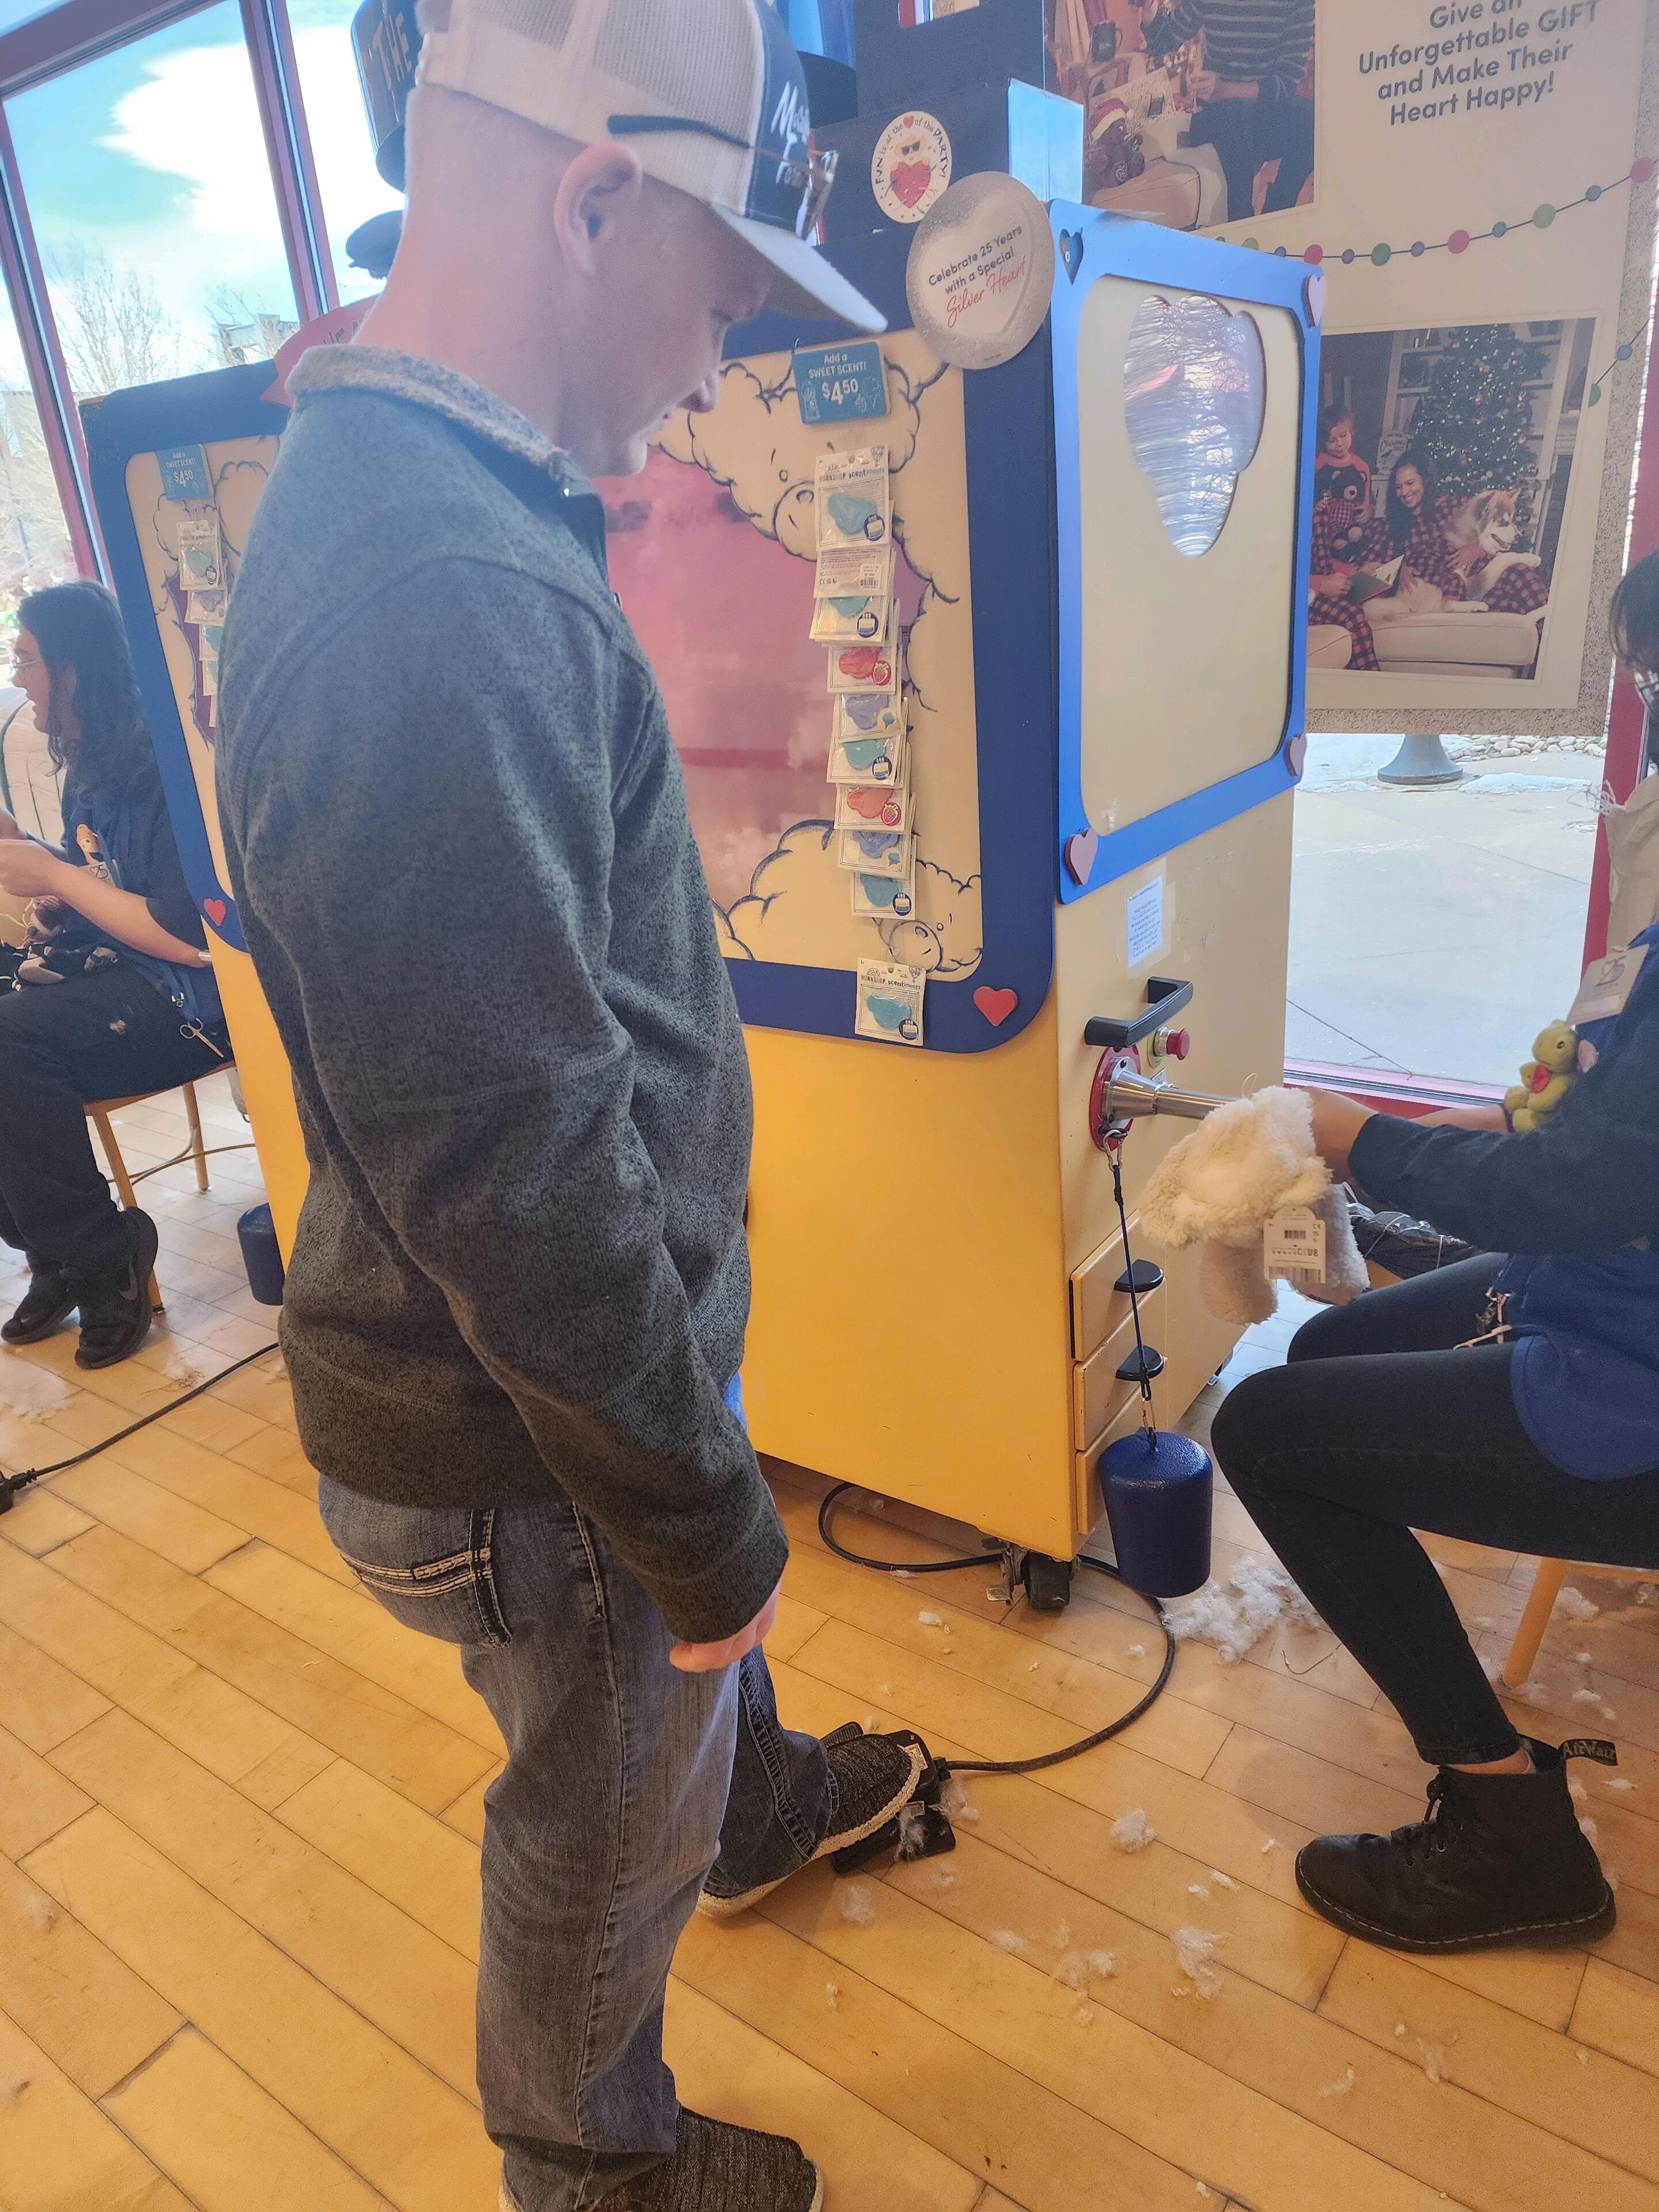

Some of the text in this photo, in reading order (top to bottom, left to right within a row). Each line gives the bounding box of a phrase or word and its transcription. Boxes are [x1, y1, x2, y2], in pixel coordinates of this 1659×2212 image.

[1429, 3, 1483, 29] Give
[1359, 0, 1600, 74] Unforgettable GIFT
[1378, 40, 1574, 100] and Make Their
[1390, 70, 1555, 126] Heart Happy!
[915, 118, 923, 126] of
[875, 157, 884, 184] FUN
[929, 226, 1022, 286] Celebrate 25 Years
[945, 246, 1014, 294] with a Special
[946, 255, 1027, 328] Silver Heart
[808, 361, 867, 378] SWEET SCENT!
[824, 353, 840, 364] Add
[861, 975, 885, 984] WORKSOP
